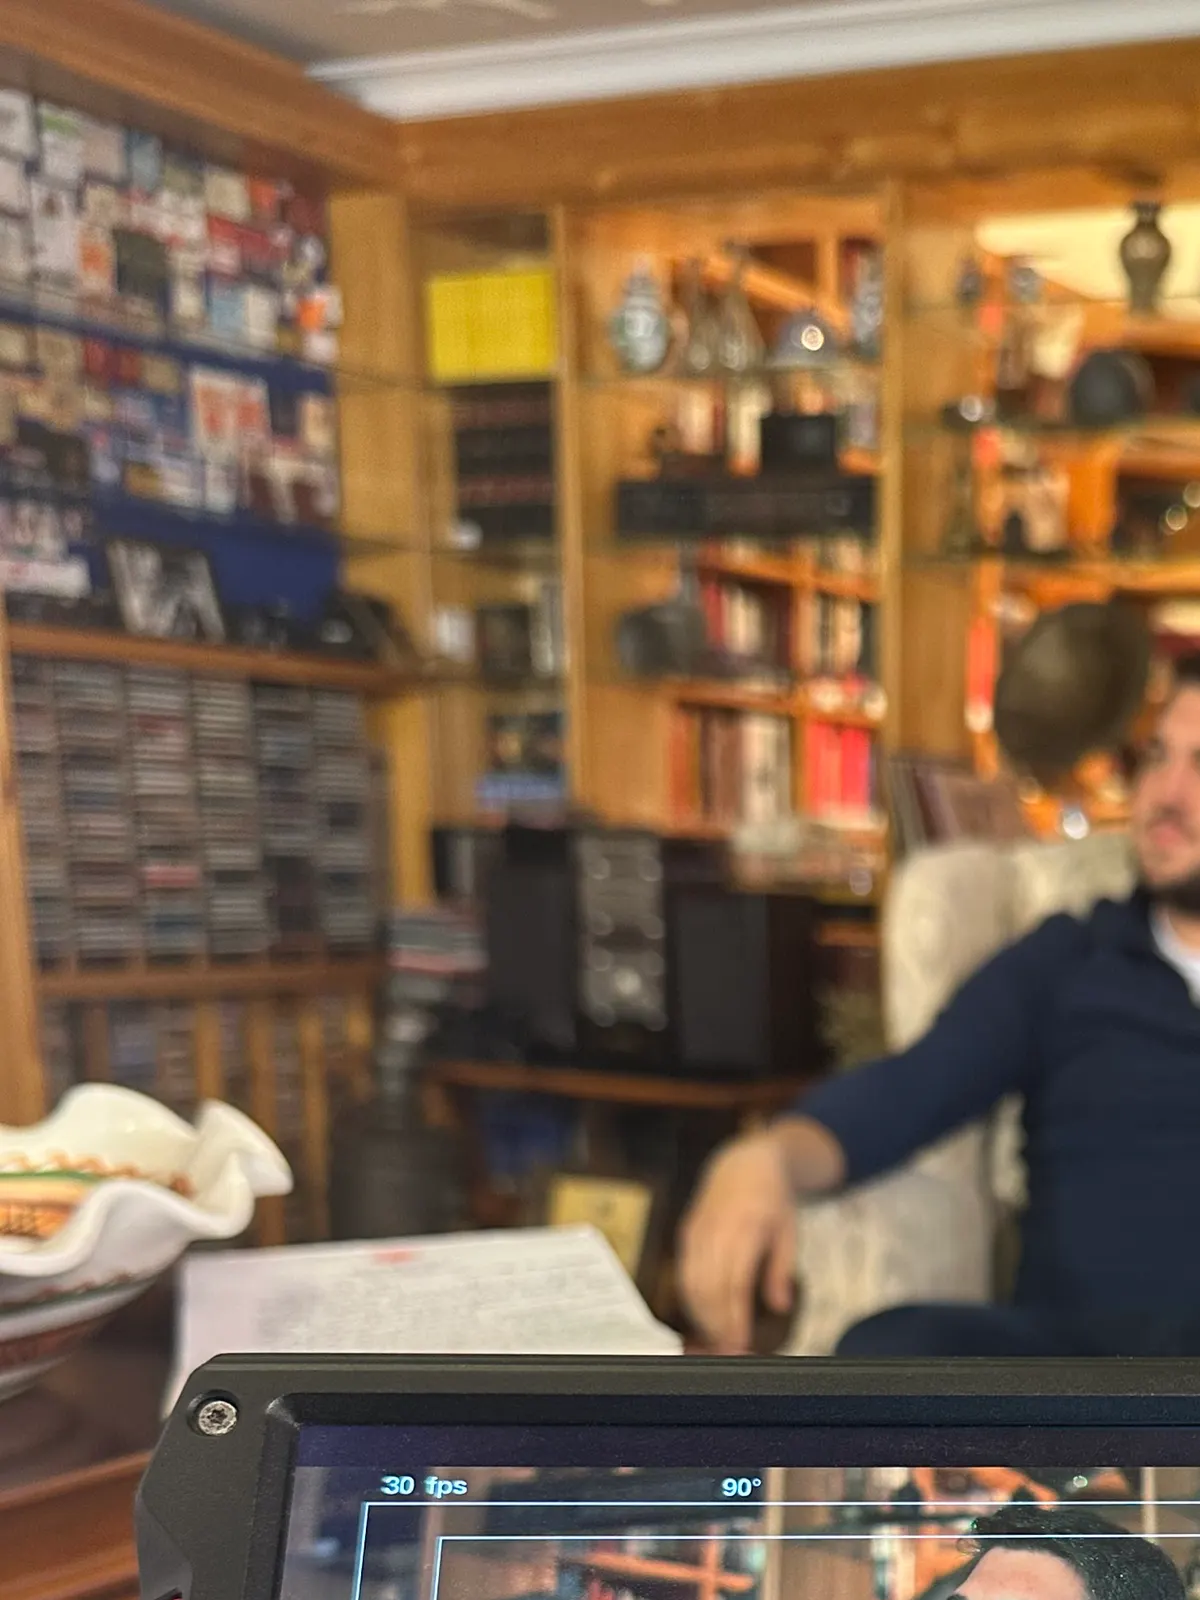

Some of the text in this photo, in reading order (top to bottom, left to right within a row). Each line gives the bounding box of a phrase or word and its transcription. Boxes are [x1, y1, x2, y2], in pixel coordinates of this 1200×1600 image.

[382, 1475, 467, 1497] 30 fps
[722, 1477, 761, 1497] 90°
